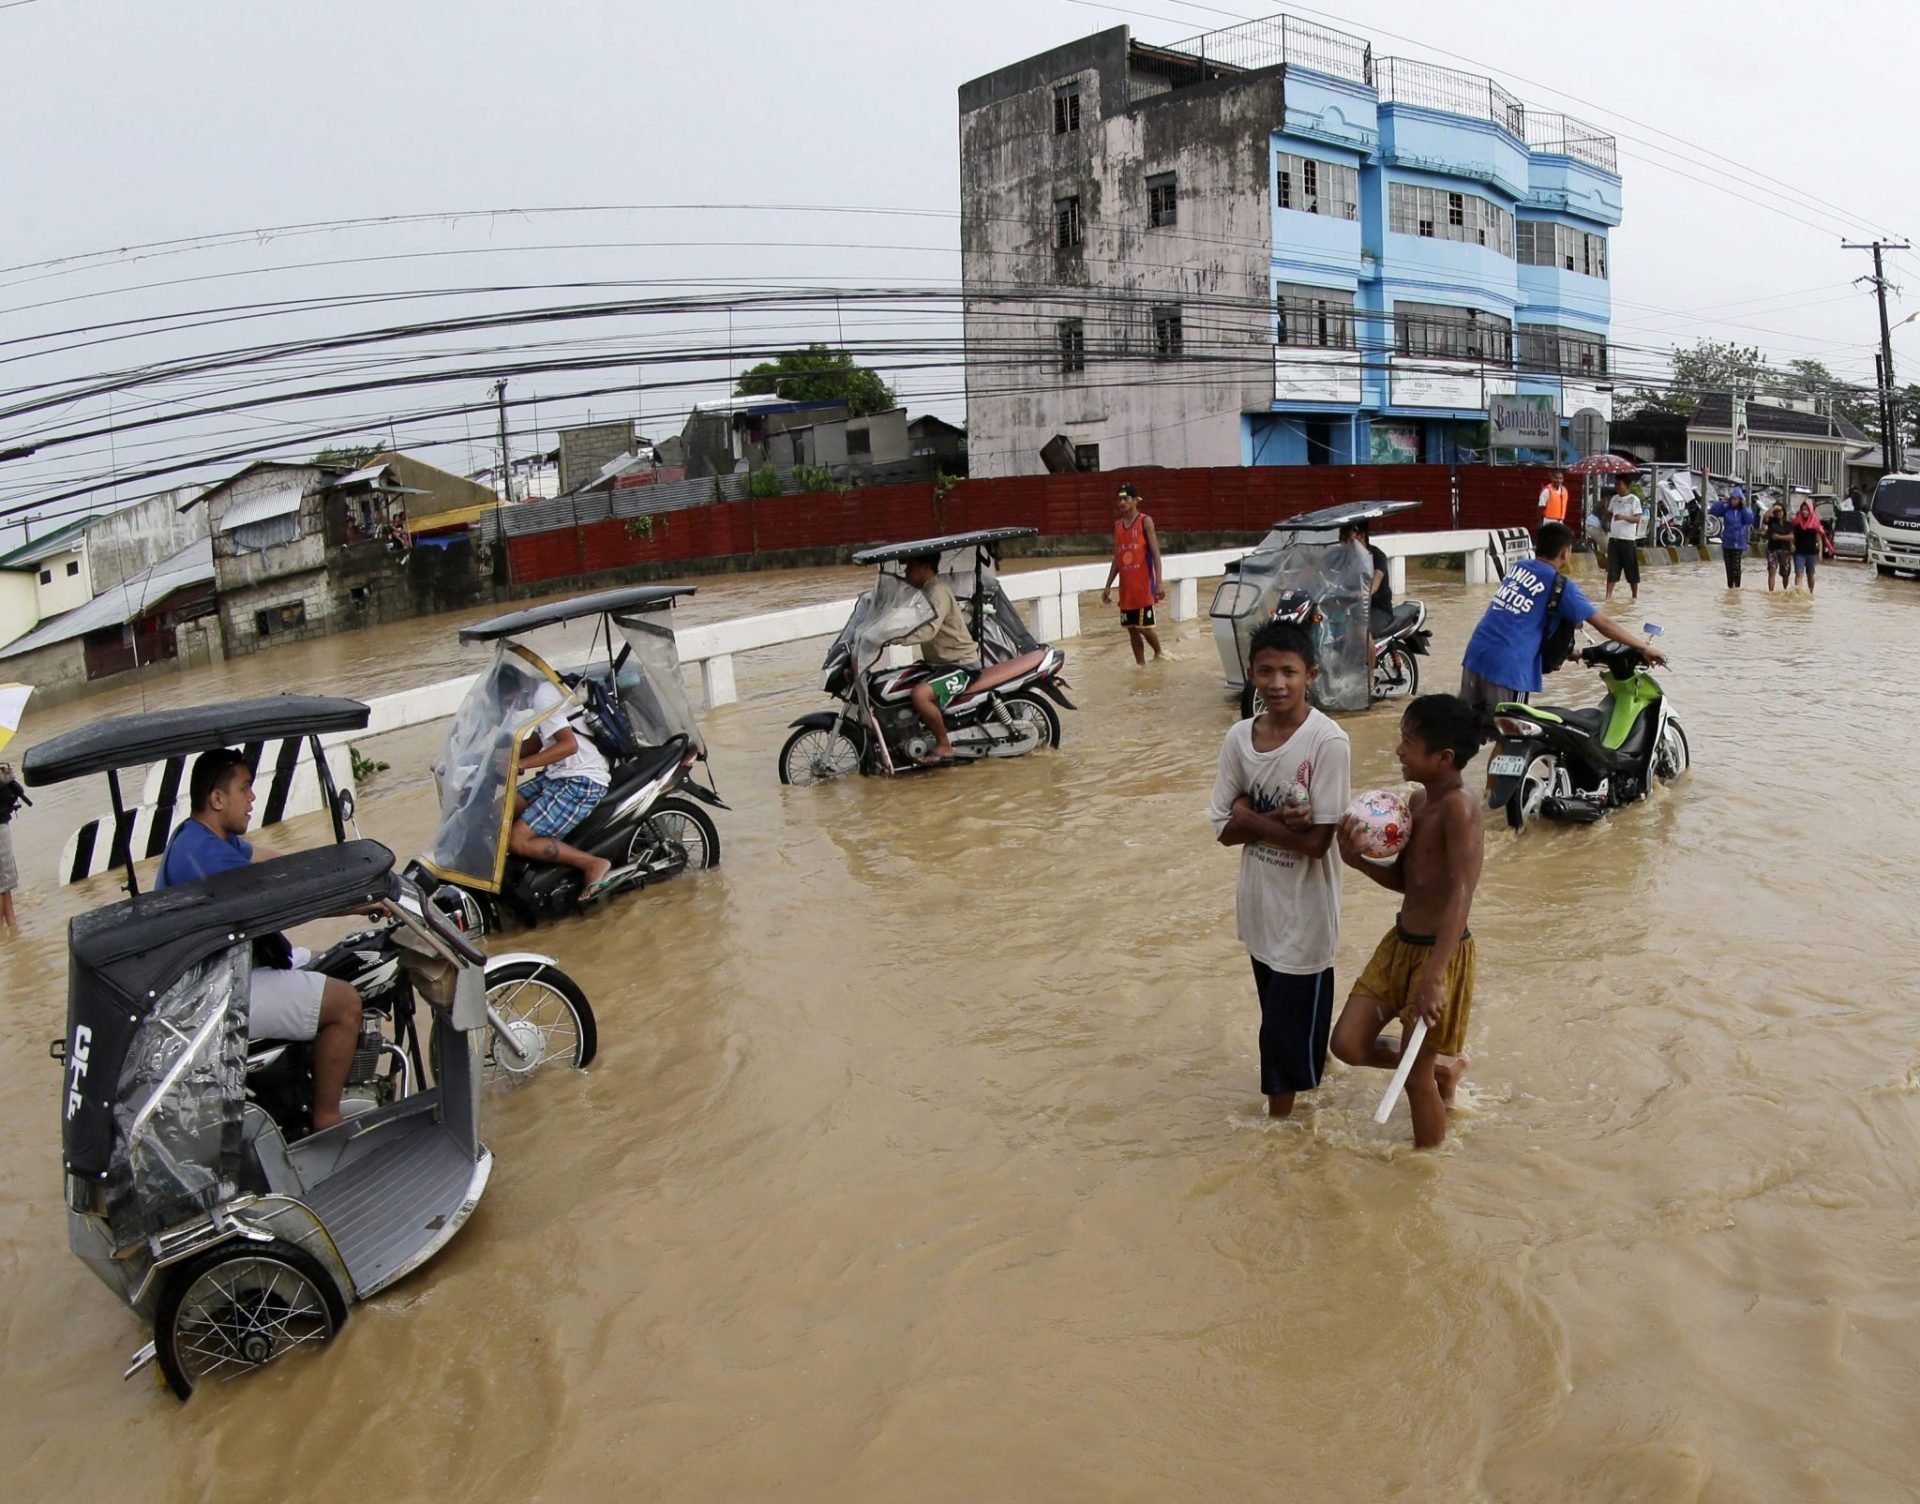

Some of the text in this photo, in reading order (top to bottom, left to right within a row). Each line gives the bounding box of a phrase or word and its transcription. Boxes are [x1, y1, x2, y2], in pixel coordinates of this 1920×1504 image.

[1503, 565, 1545, 597] UNIOR
[1497, 585, 1534, 613] ANTOS
[358, 959, 384, 970] HONDA
